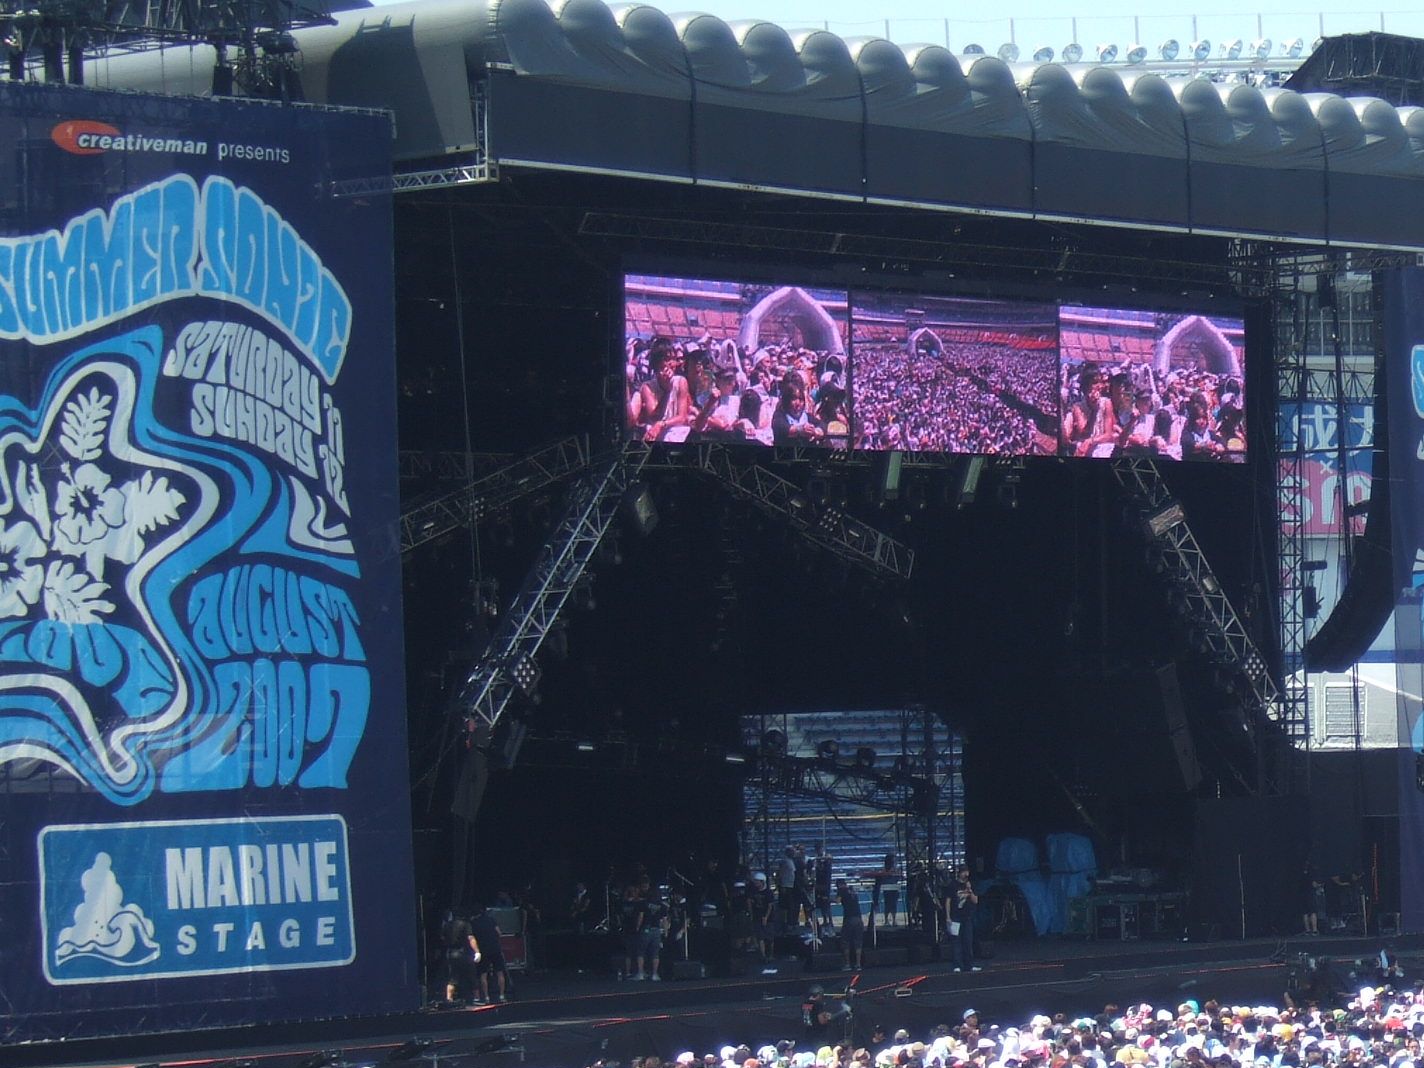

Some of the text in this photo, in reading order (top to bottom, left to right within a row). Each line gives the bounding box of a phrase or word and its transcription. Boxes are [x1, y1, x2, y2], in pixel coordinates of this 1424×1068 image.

[78, 132, 290, 164] creativeman presents
[0, 173, 353, 386] SUMMER SONIC
[187, 563, 366, 661] AUGUST
[160, 658, 371, 793] 2007
[165, 841, 339, 909] MARINE
[177, 917, 336, 955] STAGE
